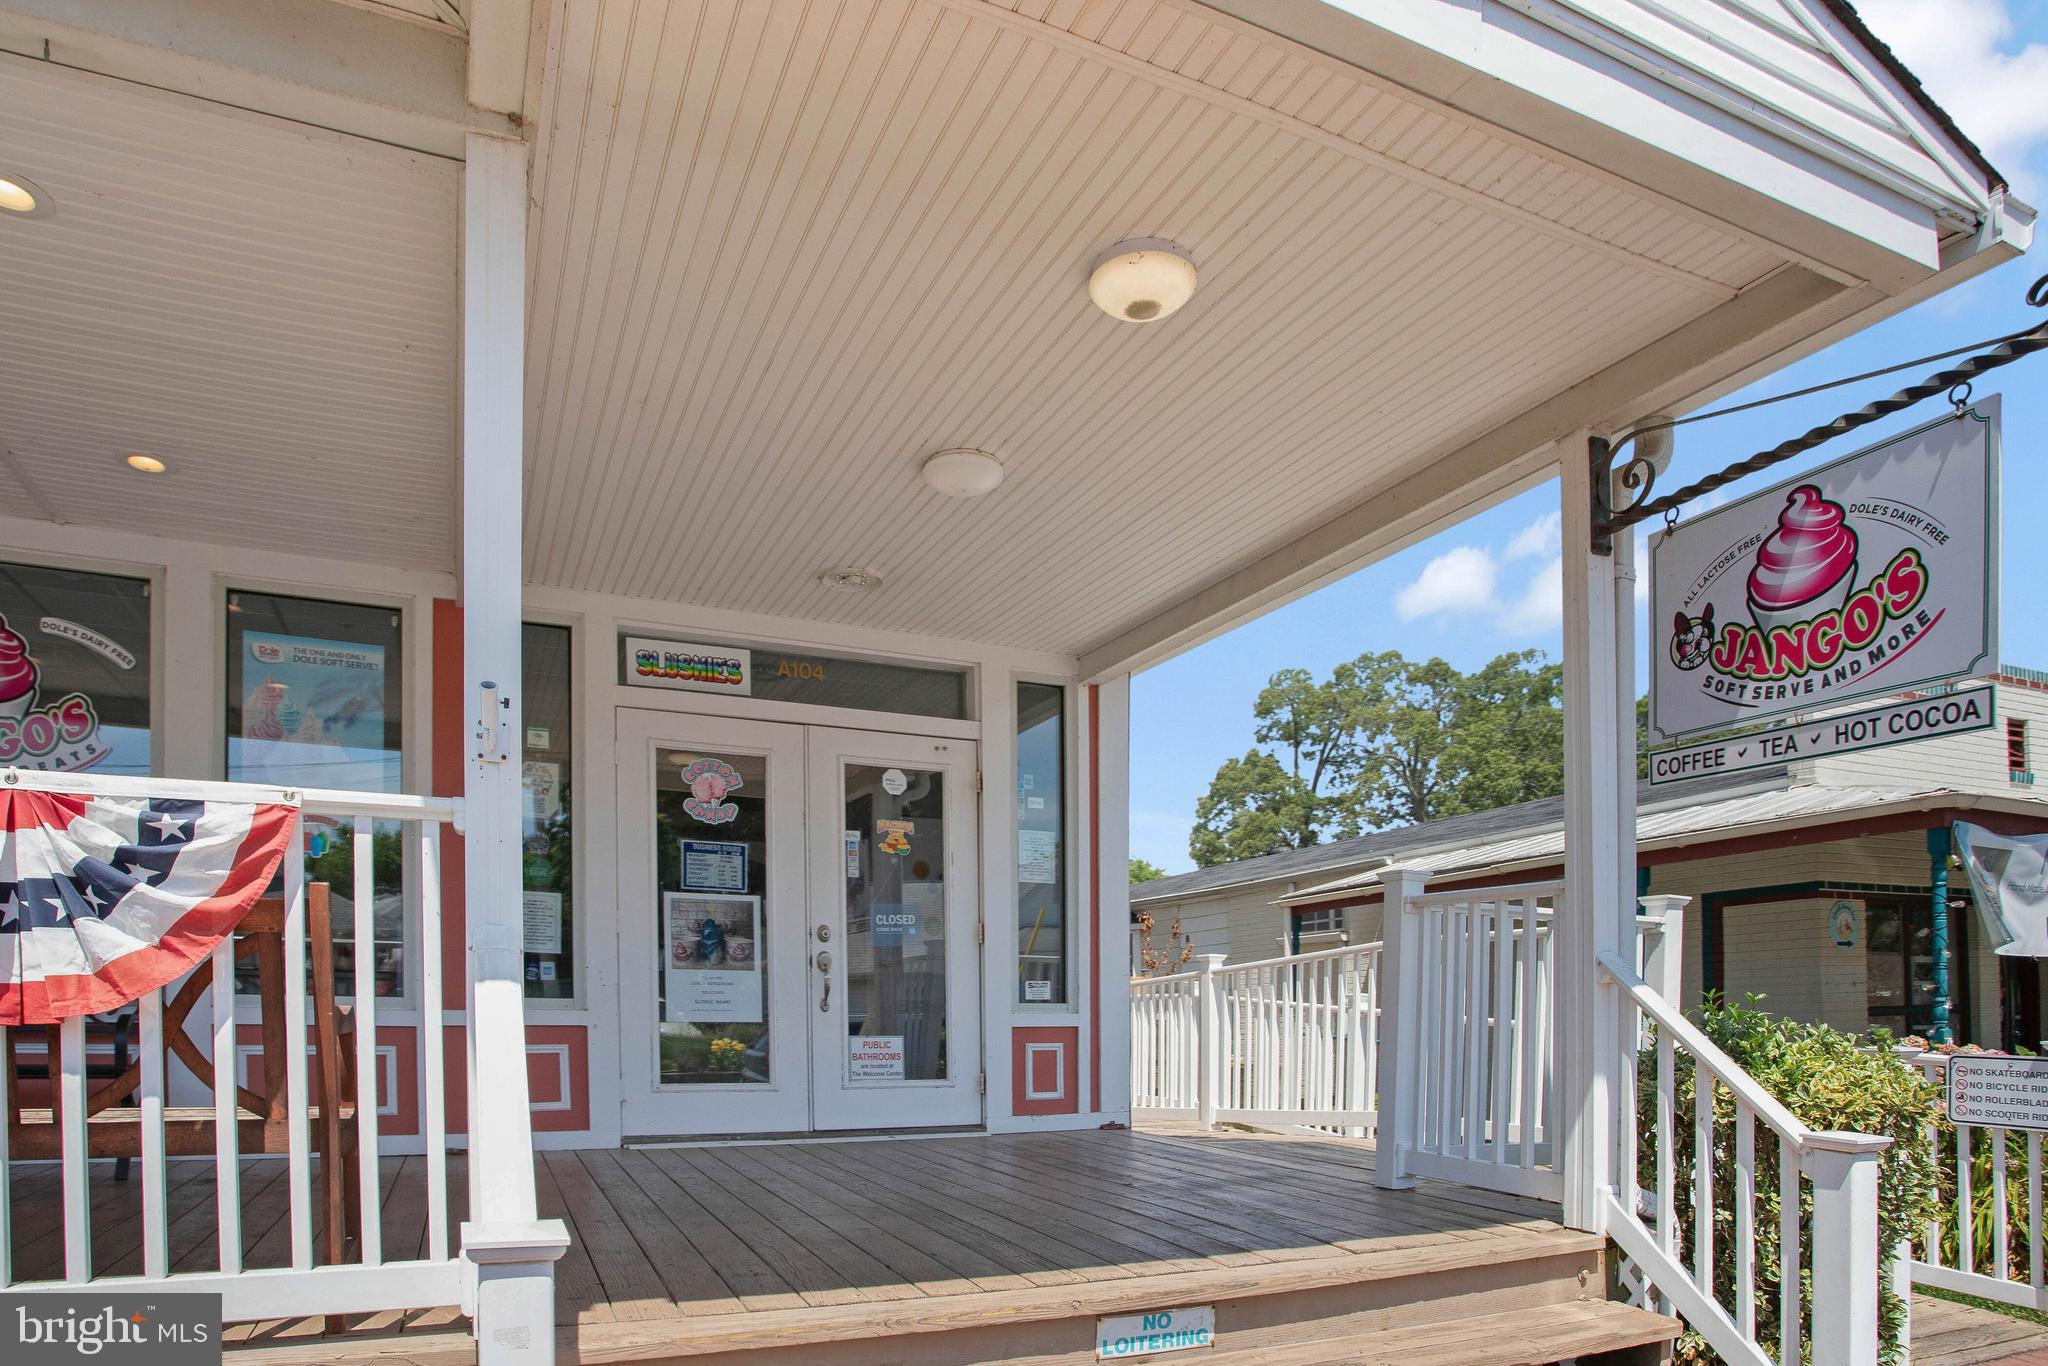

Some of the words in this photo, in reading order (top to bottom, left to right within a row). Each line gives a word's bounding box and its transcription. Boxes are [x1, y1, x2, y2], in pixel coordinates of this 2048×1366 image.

[1849, 504, 1889, 516] DOLE'S
[1890, 508, 1923, 528] DAIRY
[1923, 523, 1949, 546] FREE
[1683, 590, 1698, 608] ALL
[1697, 552, 1736, 588] LACTOSE
[1738, 533, 1762, 555] FREE
[1711, 551, 1925, 678] JANGO'S
[42, 621, 78, 636] DOLE'S
[81, 632, 110, 650] DAIRY
[112, 648, 134, 666] FREE
[293, 647, 307, 655] THE
[309, 648, 325, 657] ONE
[327, 650, 344, 659] AND
[344, 652, 367, 661] ONLY
[293, 654, 317, 665] DOLE
[320, 657, 344, 668] SOFT
[1702, 675, 1748, 699] SOFT
[1752, 678, 1814, 700] SERVE
[1821, 660, 1862, 689] AND
[1867, 609, 1932, 666] MORE
[636, 649, 743, 685] SLUSHIES
[777, 660, 825, 682] A104
[1657, 748, 1725, 777] COFFEE
[1759, 734, 1798, 758] TEA
[1835, 717, 1881, 745] HOT
[1888, 699, 1981, 736] COCOA
[684, 760, 739, 787] COTTON
[686, 802, 736, 821] CANDY
[693, 843, 721, 851] BUSINESS
[876, 914, 916, 925] CLOSED
[1969, 1068, 1983, 1076] NO
[1985, 1083, 2028, 1093] BICYCLE
[1969, 1095, 1982, 1103] NO
[1985, 1110, 2030, 1120] SCOOTER
[1143, 1312, 1172, 1330] NO
[1102, 1328, 1209, 1356] LOITERING
